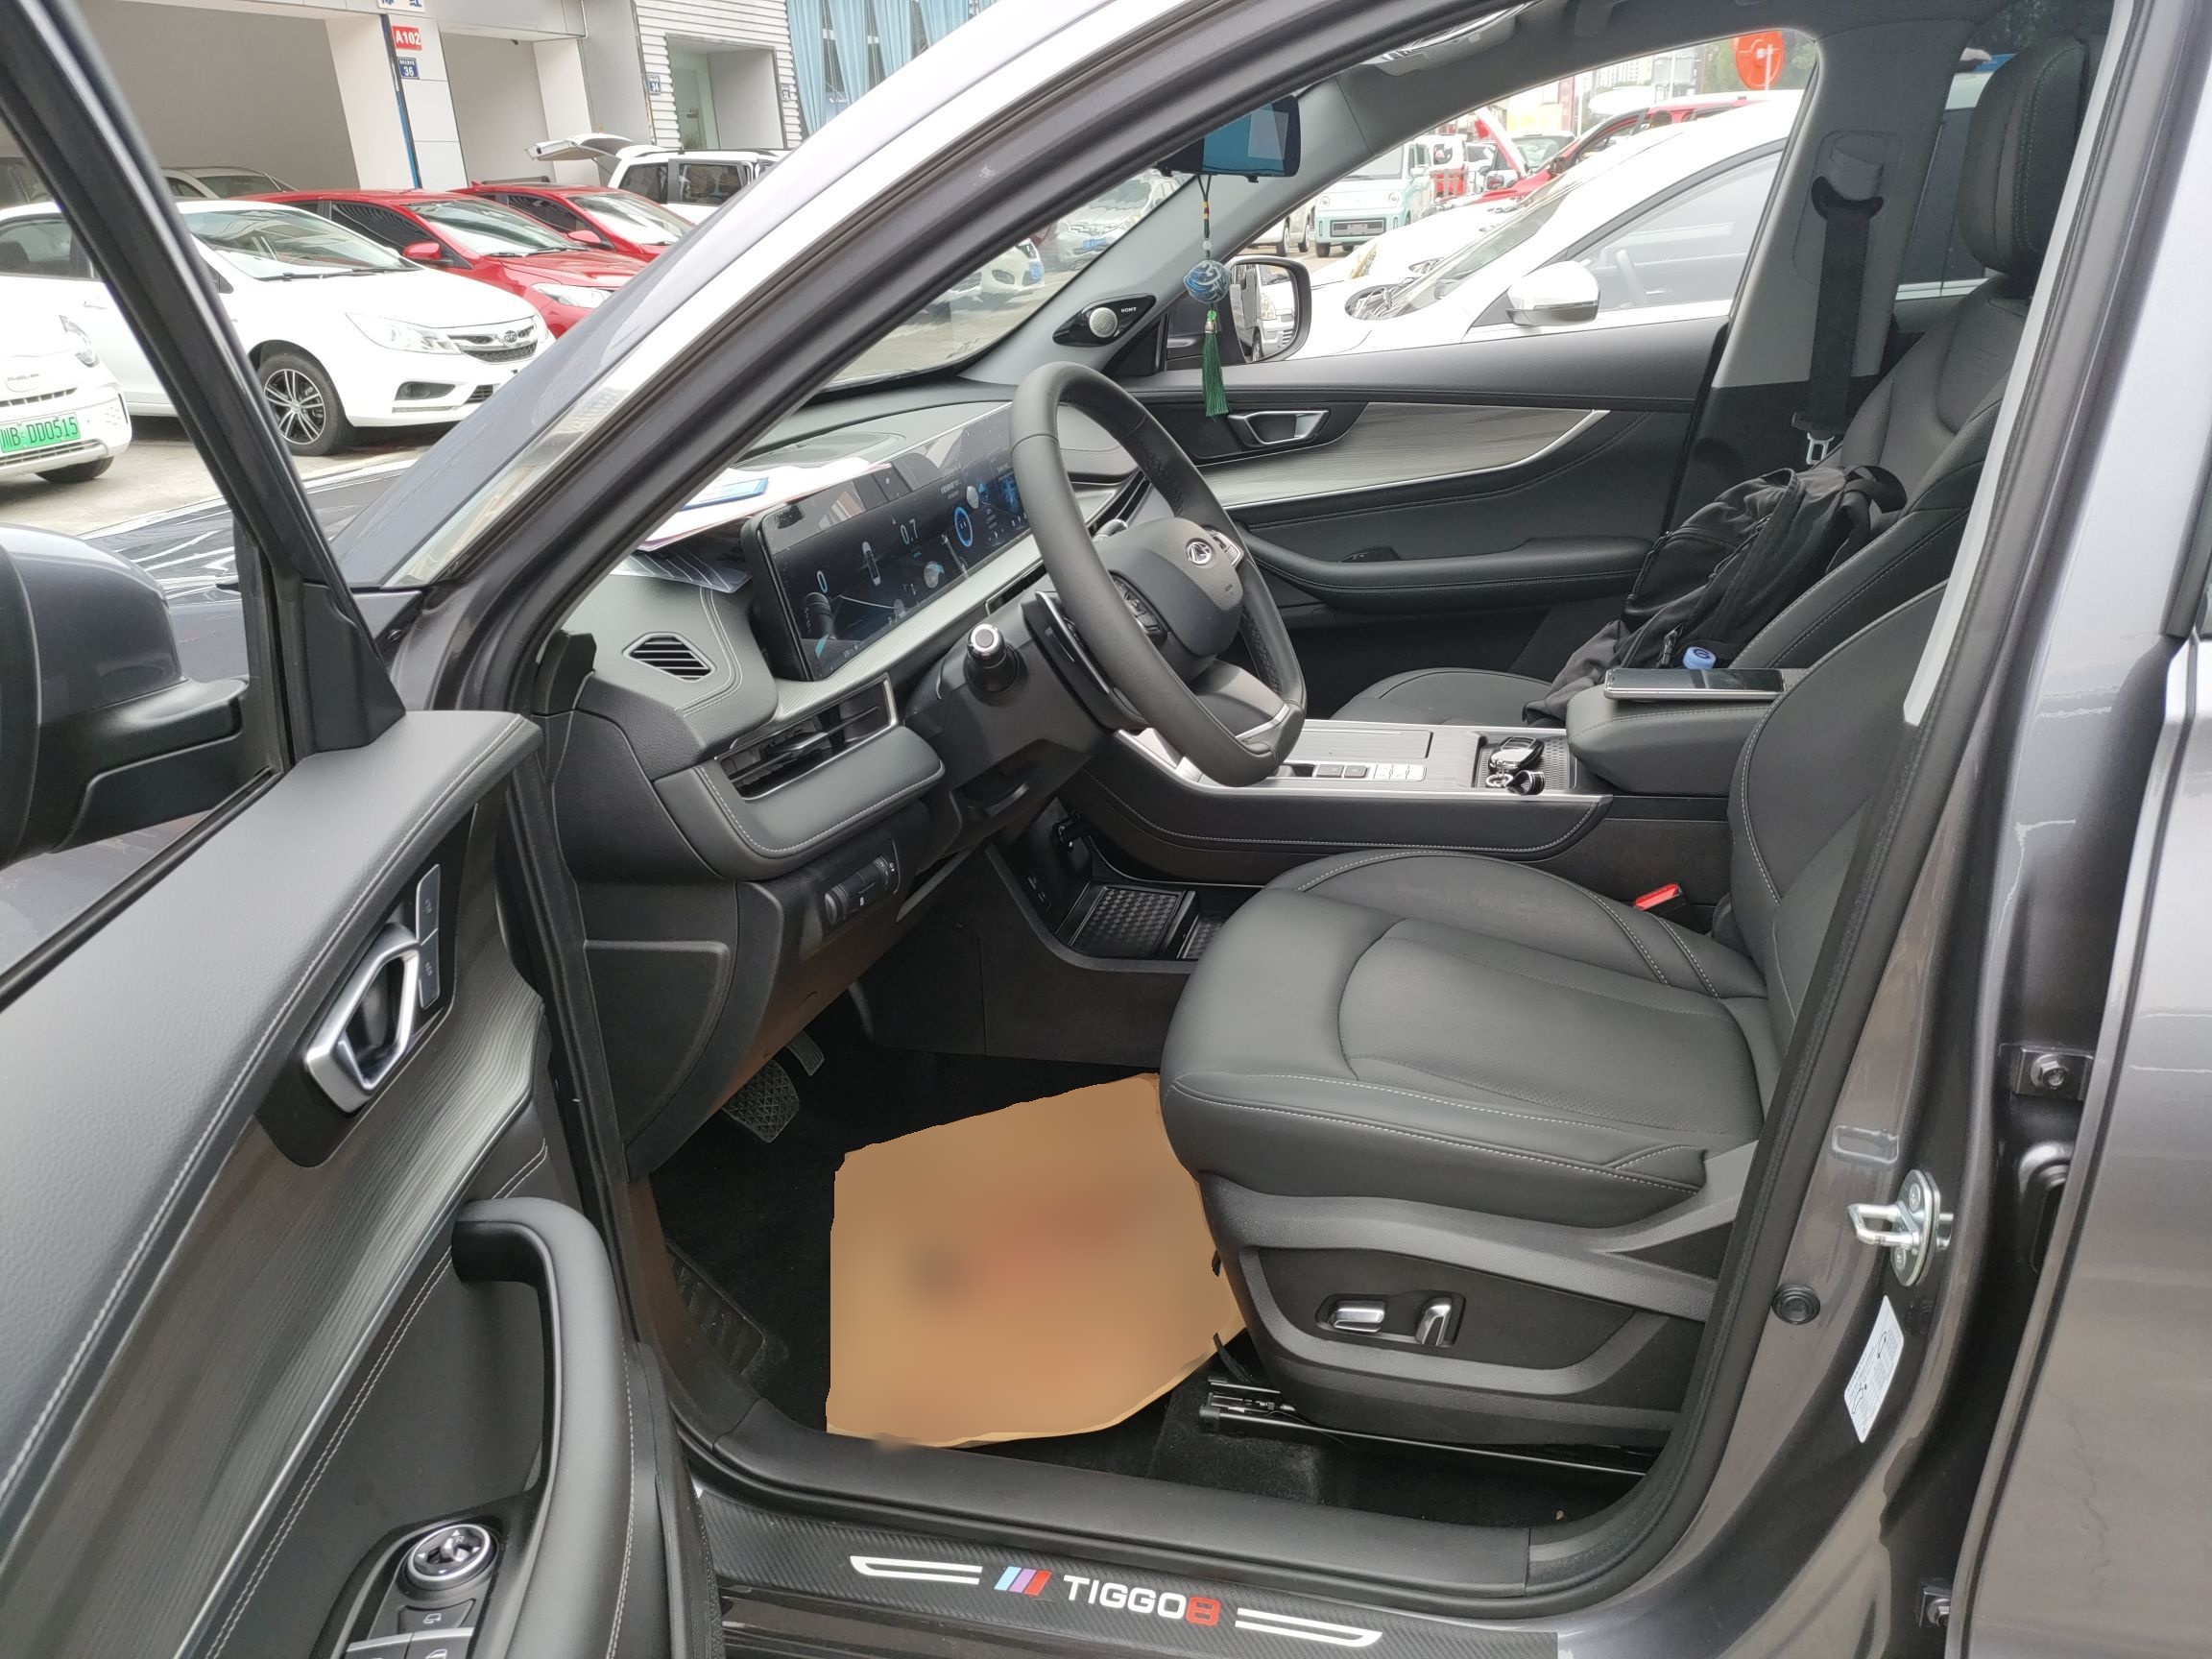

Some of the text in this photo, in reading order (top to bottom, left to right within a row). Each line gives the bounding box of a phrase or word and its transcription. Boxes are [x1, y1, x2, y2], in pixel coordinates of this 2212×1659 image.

[396, 30, 421, 46] A102
[403, 66, 415, 76] 36
[900, 518, 919, 545] 0.7
[816, 570, 829, 593] 0
[1063, 1574, 1221, 1626] TIGGO8
